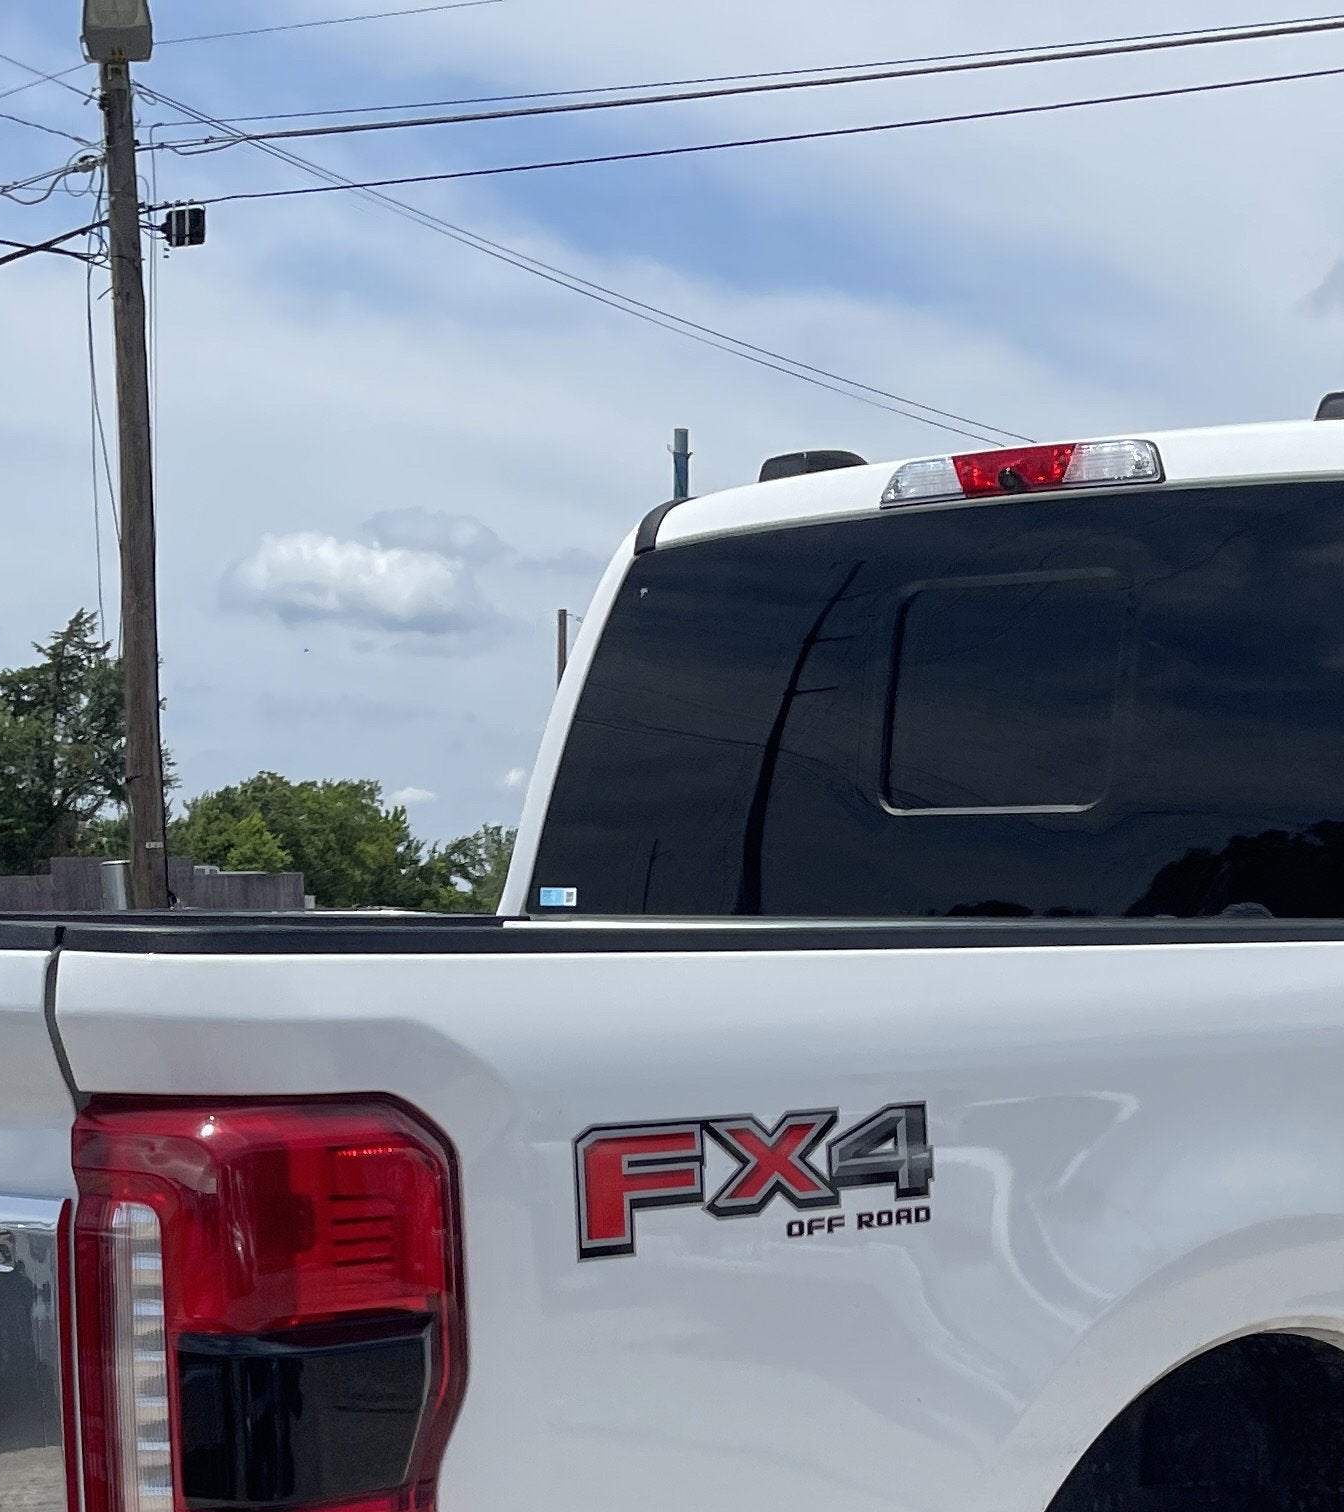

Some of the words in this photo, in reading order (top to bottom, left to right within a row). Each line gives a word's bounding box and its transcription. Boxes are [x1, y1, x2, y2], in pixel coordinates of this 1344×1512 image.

[571, 1100, 935, 1263] FX4
[786, 1214, 846, 1238] OFF
[857, 1206, 932, 1230] ROAD
